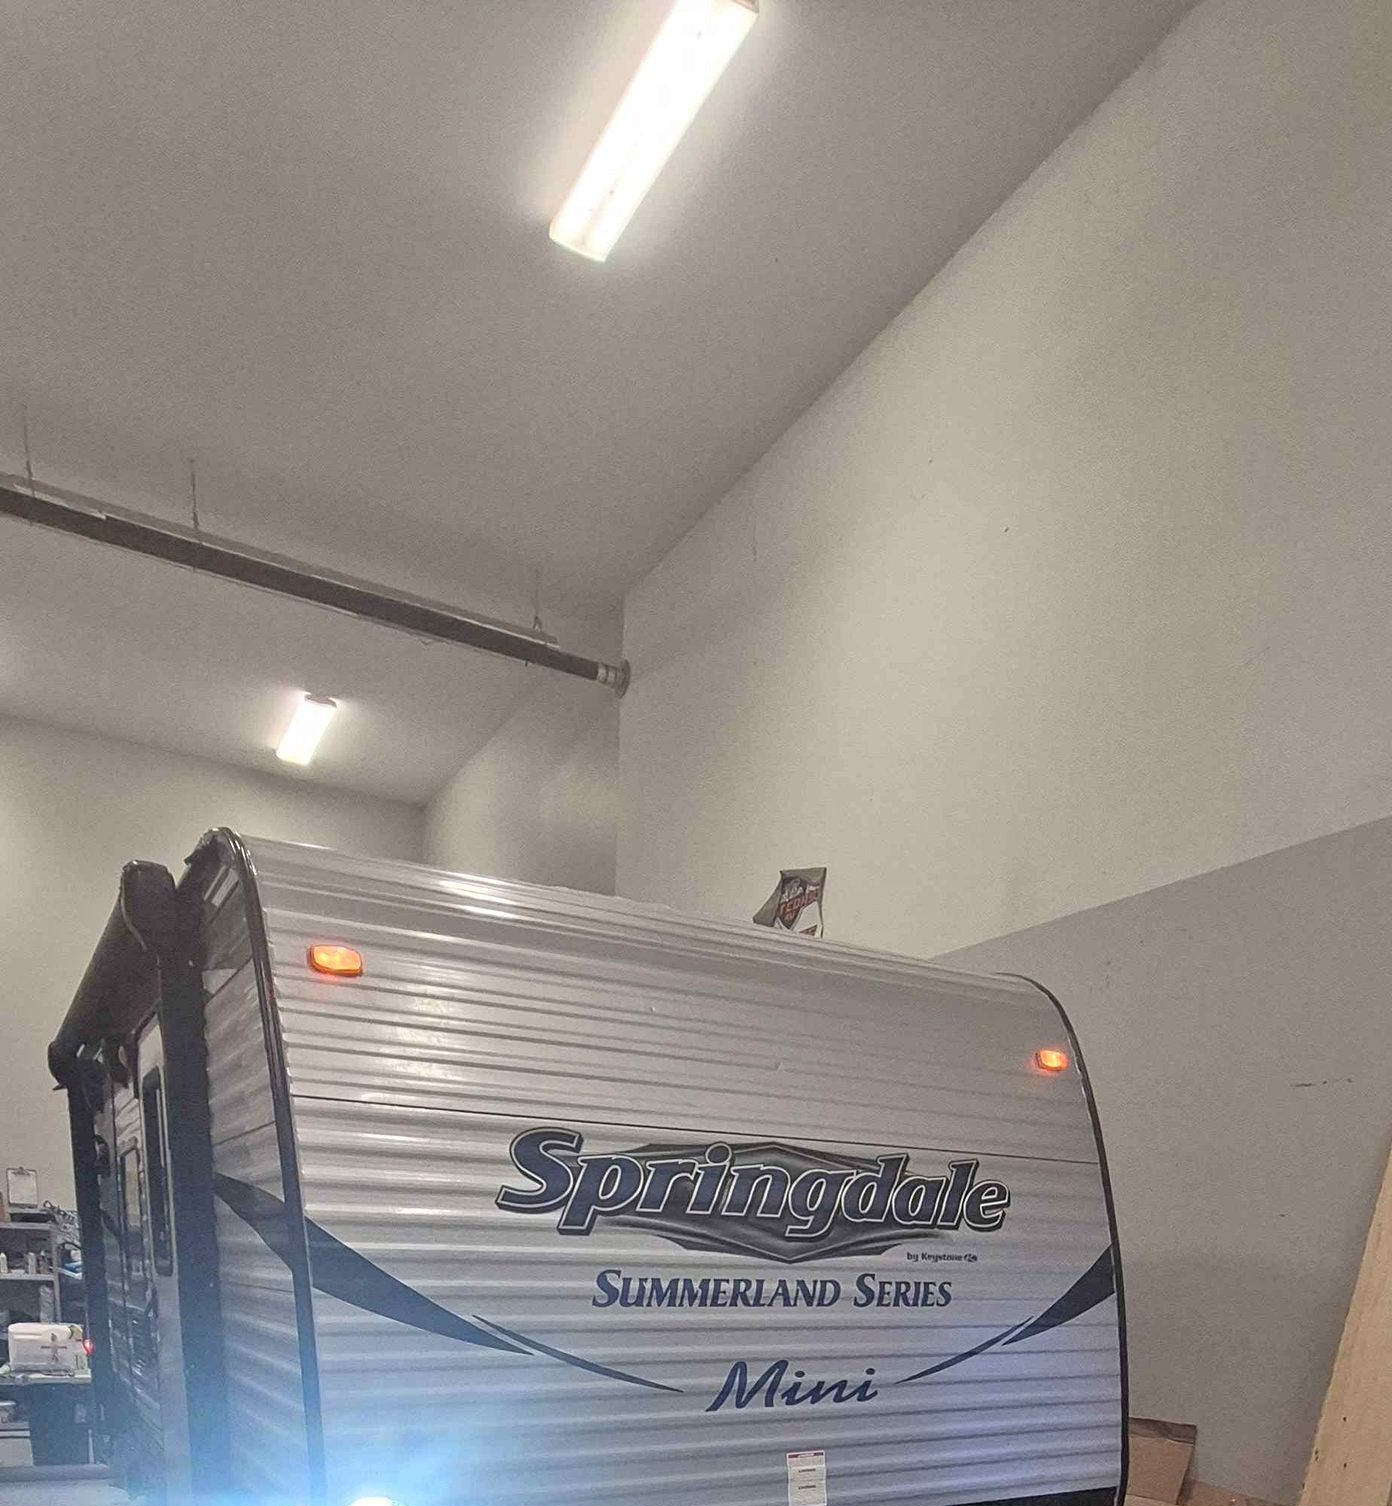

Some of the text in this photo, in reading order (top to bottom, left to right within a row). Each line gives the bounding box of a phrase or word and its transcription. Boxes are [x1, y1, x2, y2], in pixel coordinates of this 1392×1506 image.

[495, 1126, 1010, 1239] Springdale
[906, 1252, 919, 1263] by
[592, 1269, 952, 1308] SUMMERLAND SERIES
[705, 1359, 879, 1412] Mini
